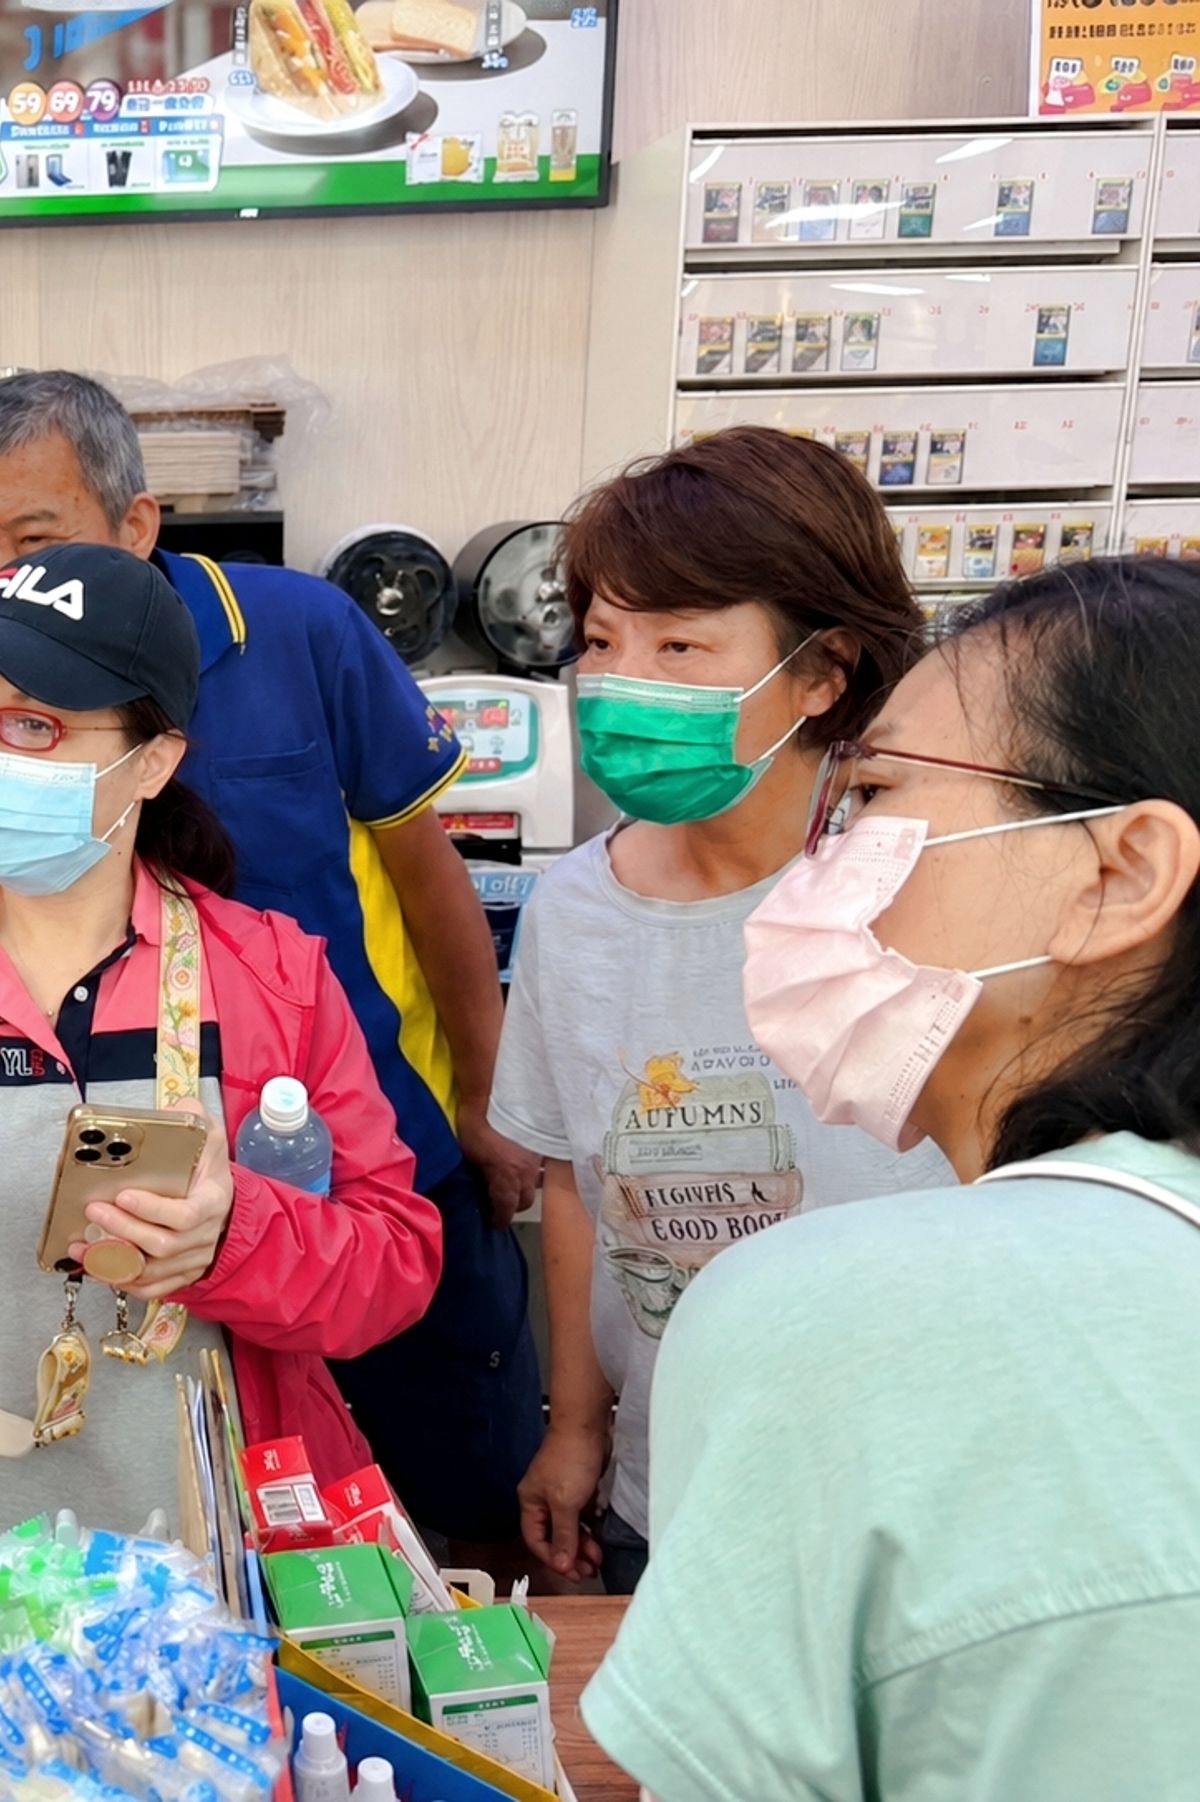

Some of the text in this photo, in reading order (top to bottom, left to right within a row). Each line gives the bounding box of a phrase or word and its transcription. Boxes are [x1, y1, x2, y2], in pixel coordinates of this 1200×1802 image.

[13, 92, 41, 115] 59
[52, 90, 80, 113] 69
[88, 89, 115, 113] 79
